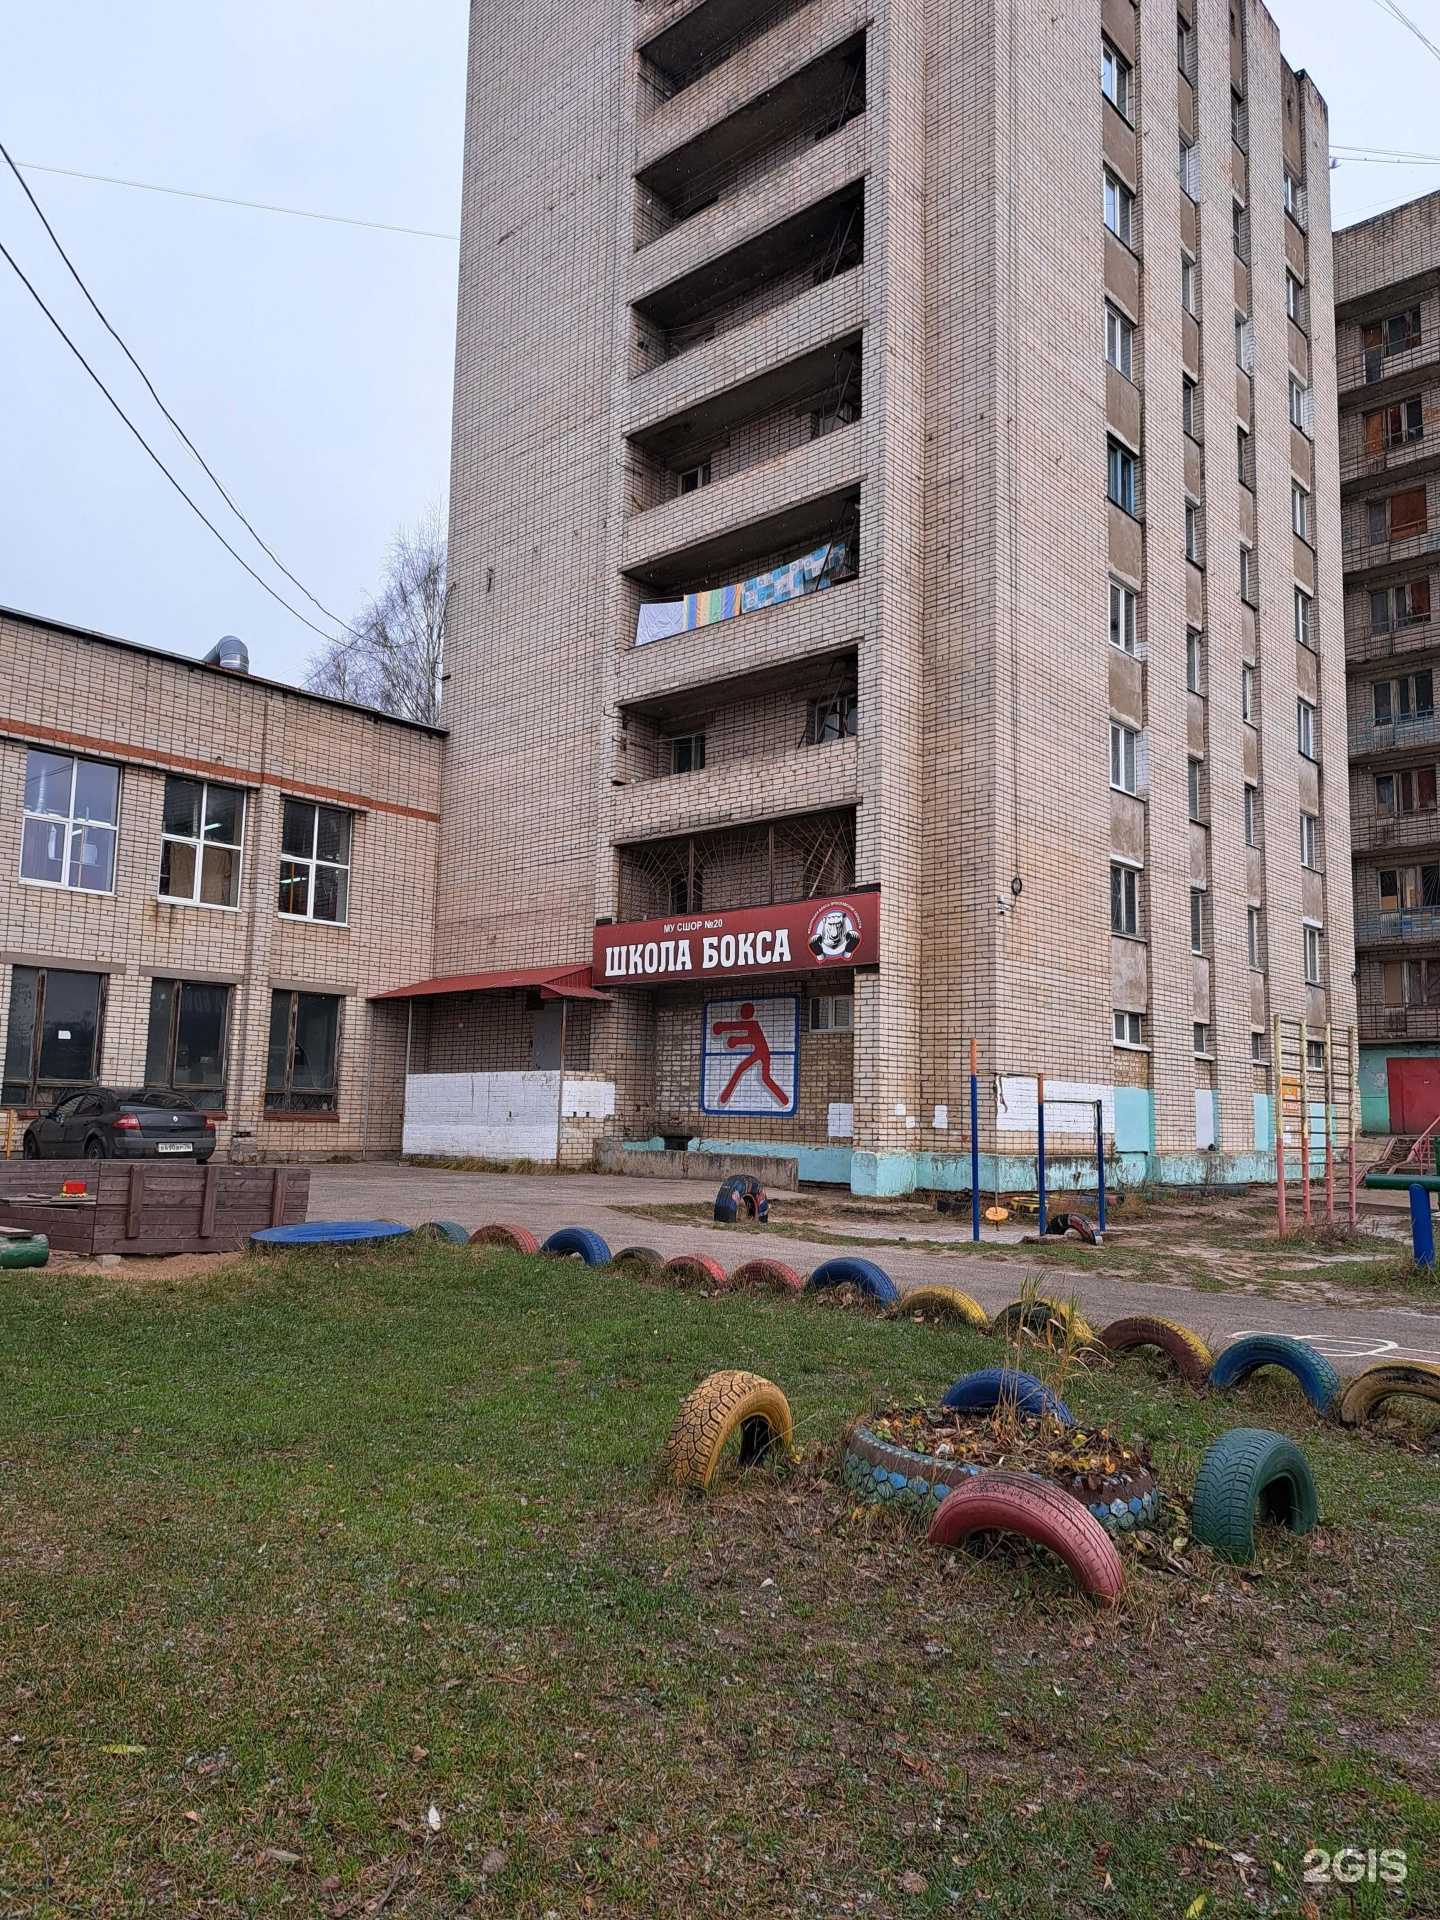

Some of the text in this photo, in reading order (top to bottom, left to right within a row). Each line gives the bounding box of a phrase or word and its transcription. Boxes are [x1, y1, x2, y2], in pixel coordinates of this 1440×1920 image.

[663, 918, 723, 933] МУ СШОР №20
[605, 928, 792, 977] ШКОЛА БОКСА
